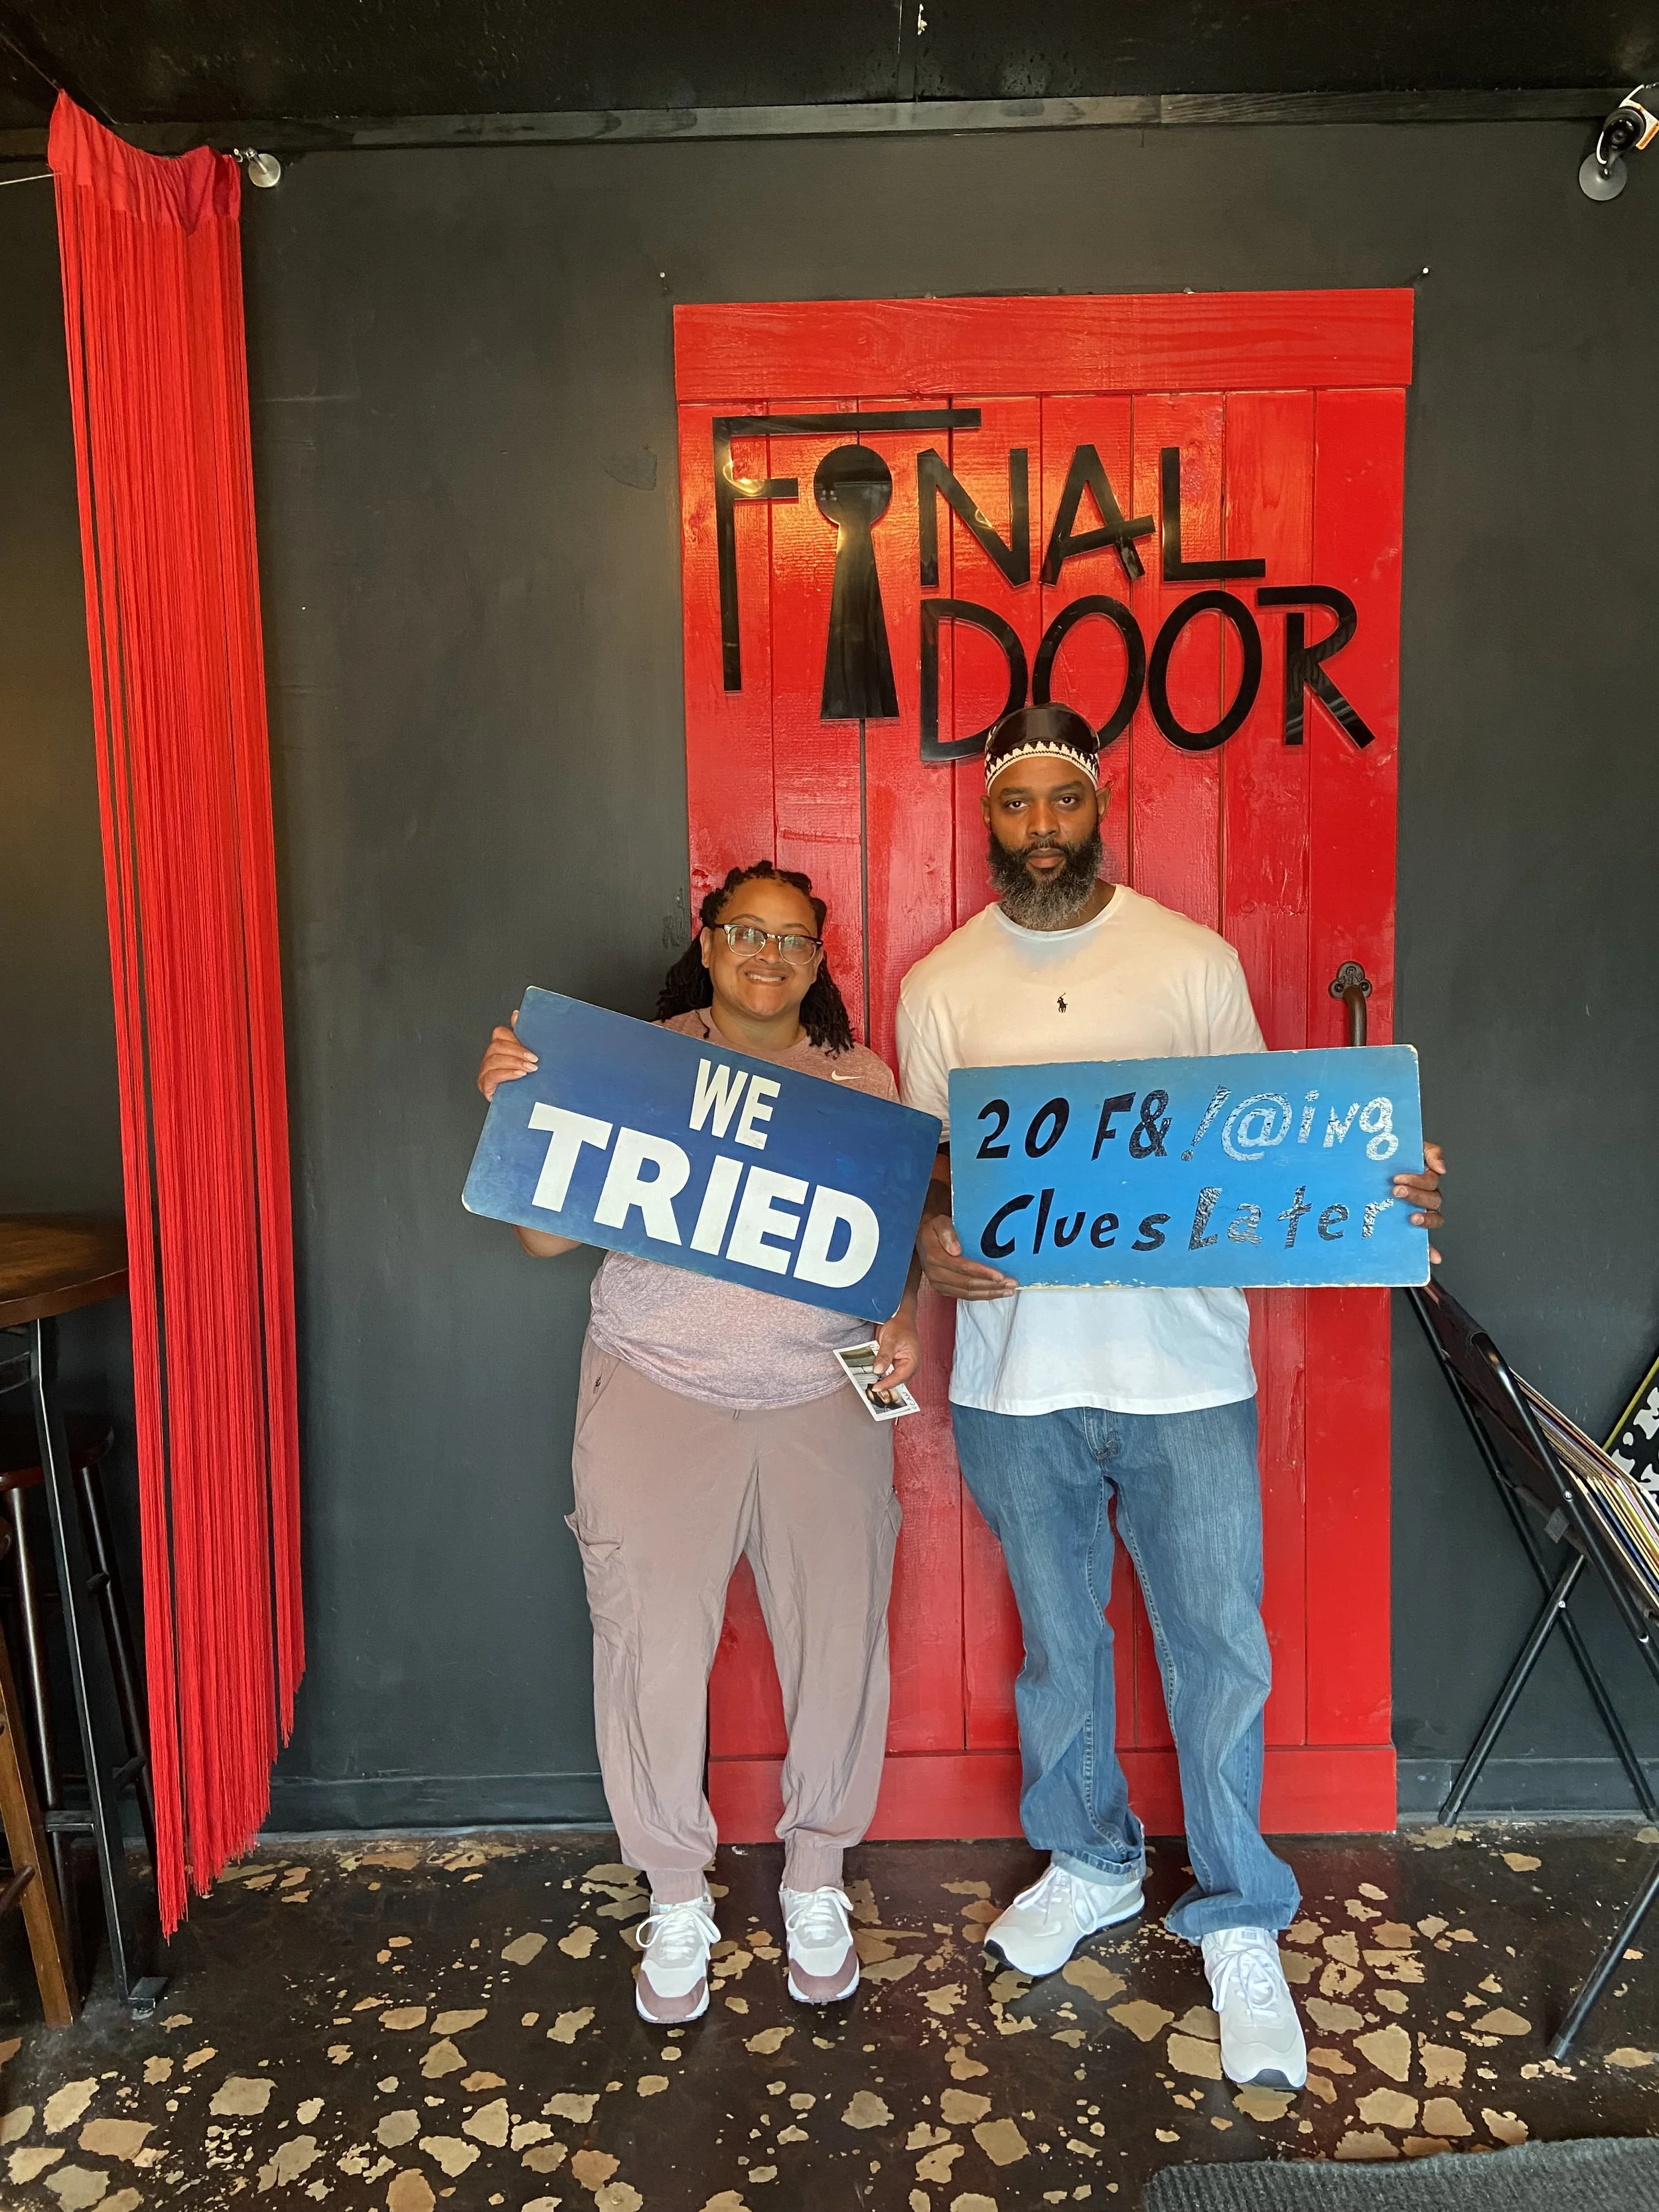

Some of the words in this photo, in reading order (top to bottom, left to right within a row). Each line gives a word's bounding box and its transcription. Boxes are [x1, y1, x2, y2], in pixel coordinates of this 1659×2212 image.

[921, 585, 1376, 762] DOOR
[689, 1058, 781, 1149] WE
[976, 1096, 1070, 1159] 20
[528, 1102, 879, 1288] TRIED
[980, 1188, 1172, 1259] Clues
[1188, 1185, 1394, 1252] Later
